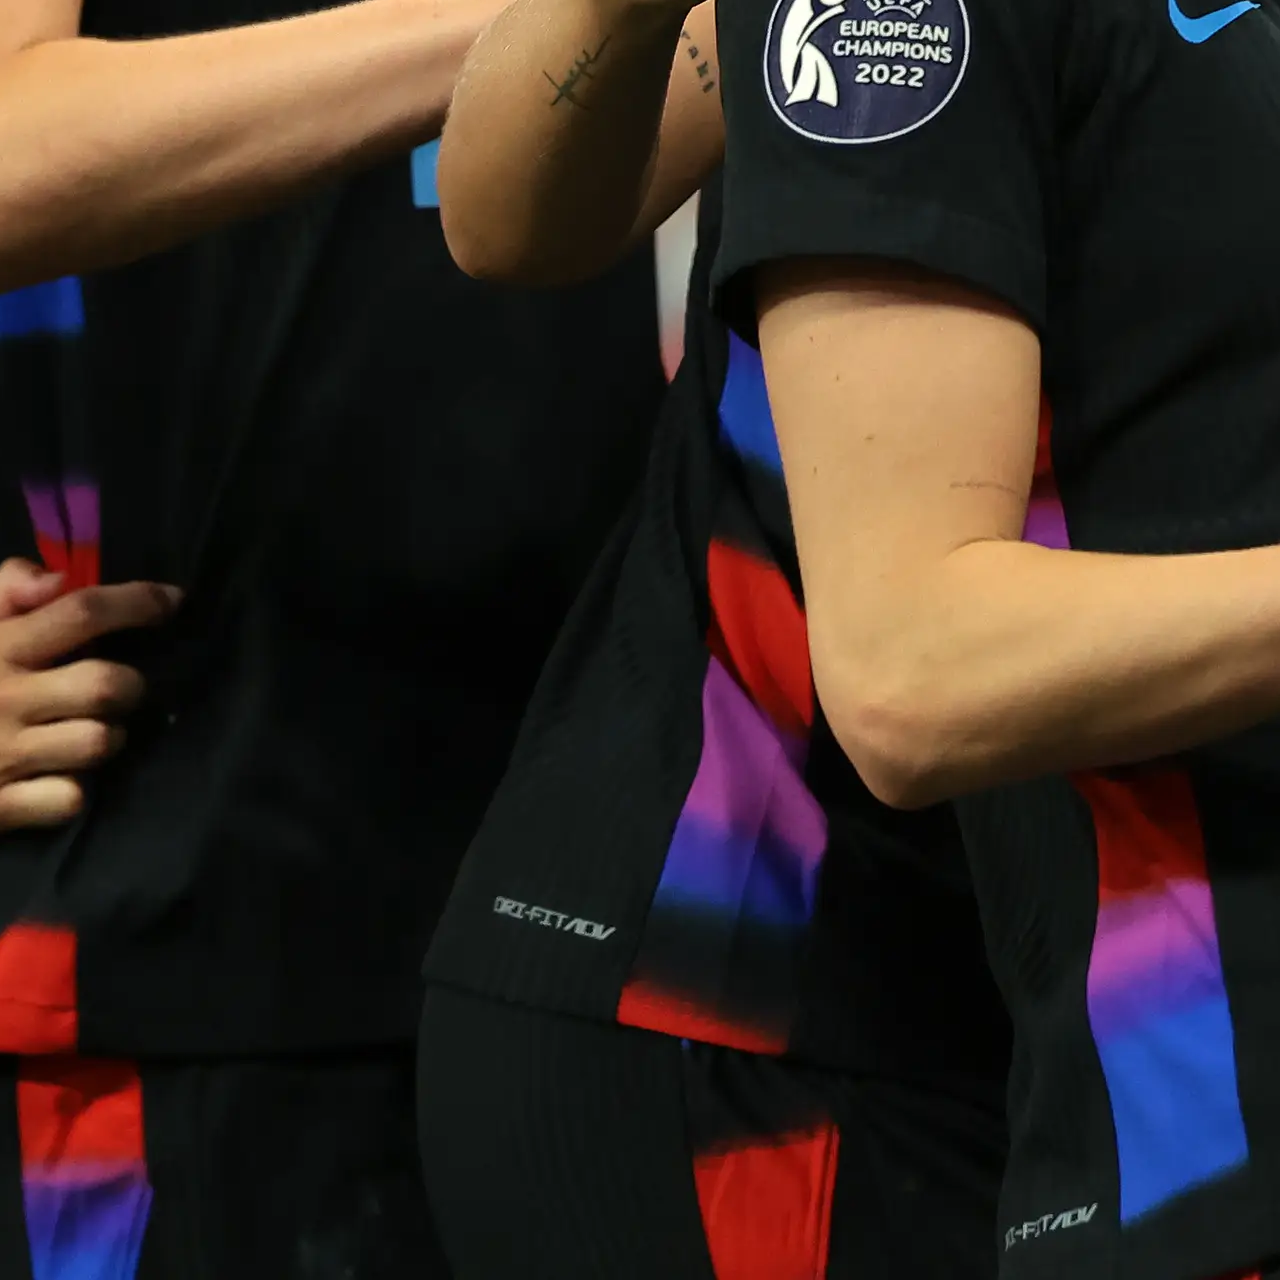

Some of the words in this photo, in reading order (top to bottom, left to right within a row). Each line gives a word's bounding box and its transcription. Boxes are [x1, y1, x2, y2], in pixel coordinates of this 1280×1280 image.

[839, 19, 949, 42] EUROPEAN
[832, 40, 953, 63] CHAMPIONS
[854, 63, 925, 87] 2022
